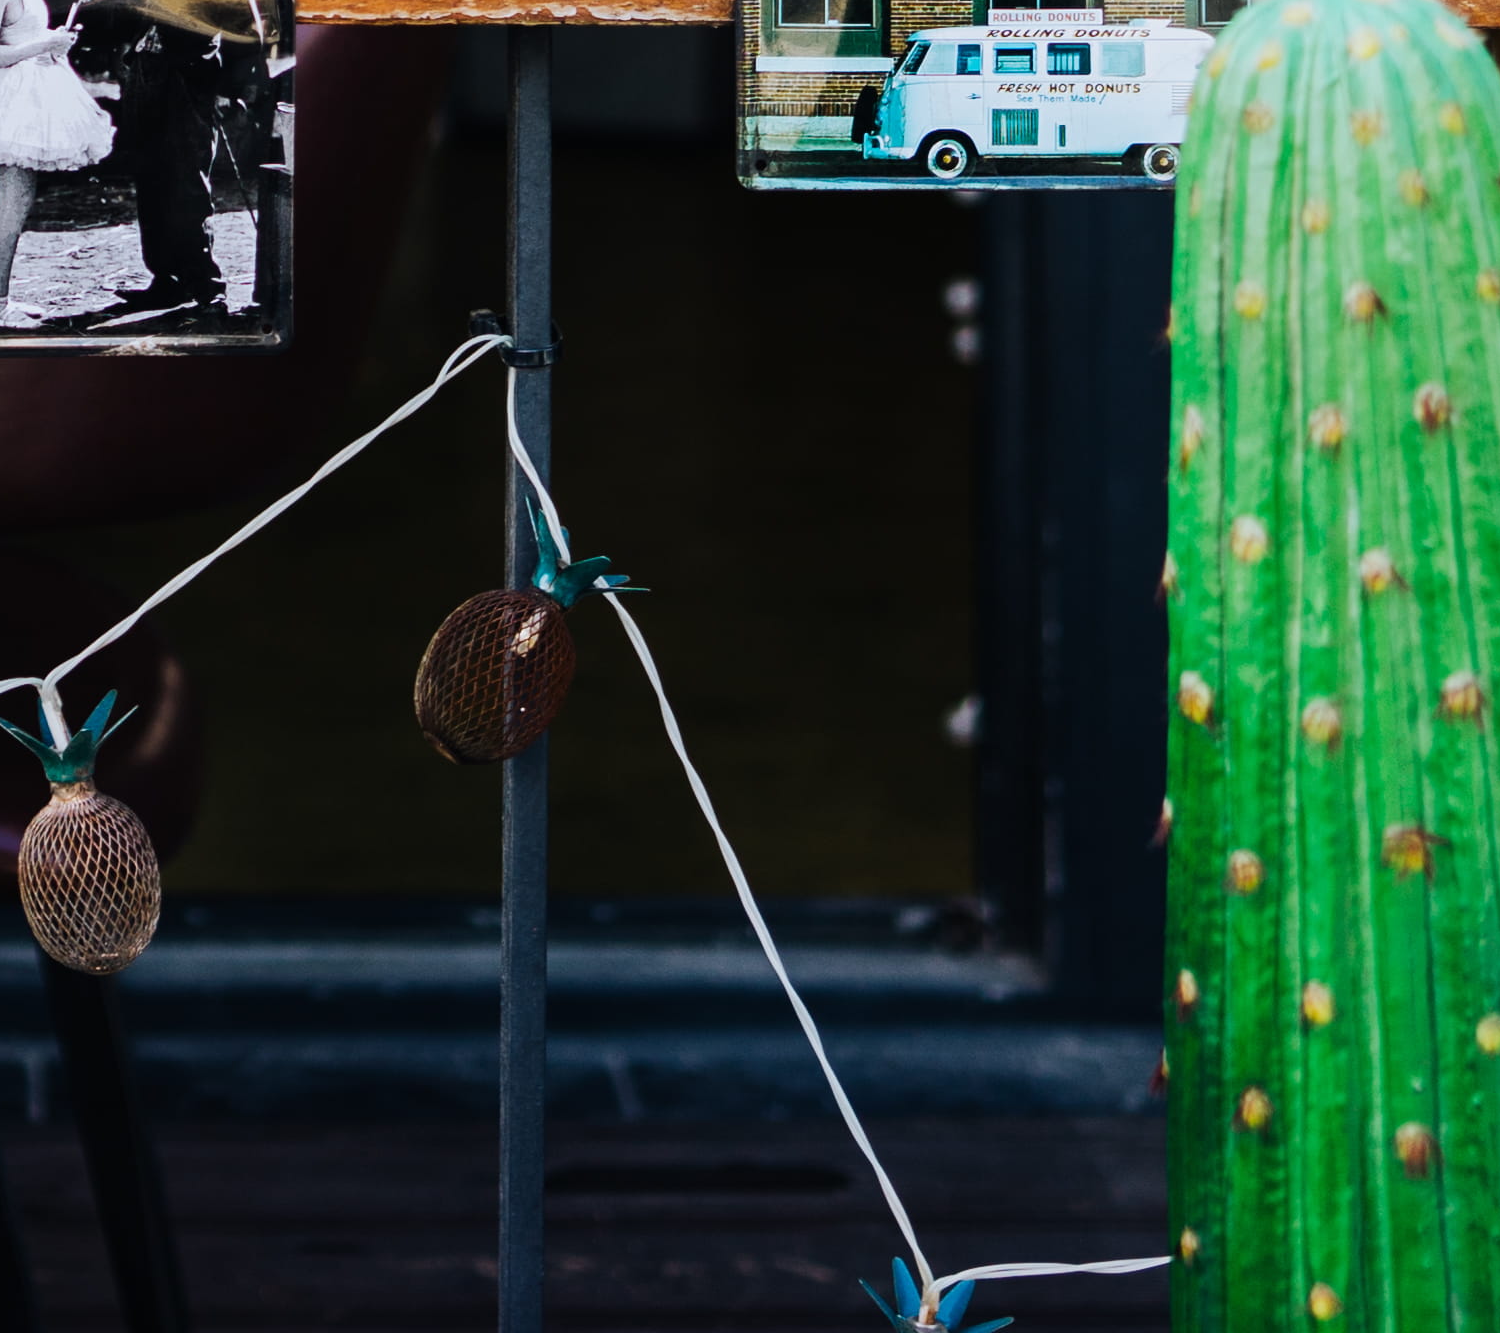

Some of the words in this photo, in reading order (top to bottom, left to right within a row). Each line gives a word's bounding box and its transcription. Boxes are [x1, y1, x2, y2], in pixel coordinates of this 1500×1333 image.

[993, 12, 1042, 22] ROLLING
[1048, 12, 1096, 22] DONUTS
[986, 29, 1066, 38] ROLLING
[1074, 29, 1152, 38] DONUTS
[997, 83, 1042, 94] FRESH
[1050, 83, 1075, 94] HOT
[1085, 83, 1141, 94] DONUTS
[1016, 94, 1033, 103] See
[1039, 94, 1065, 103] Them
